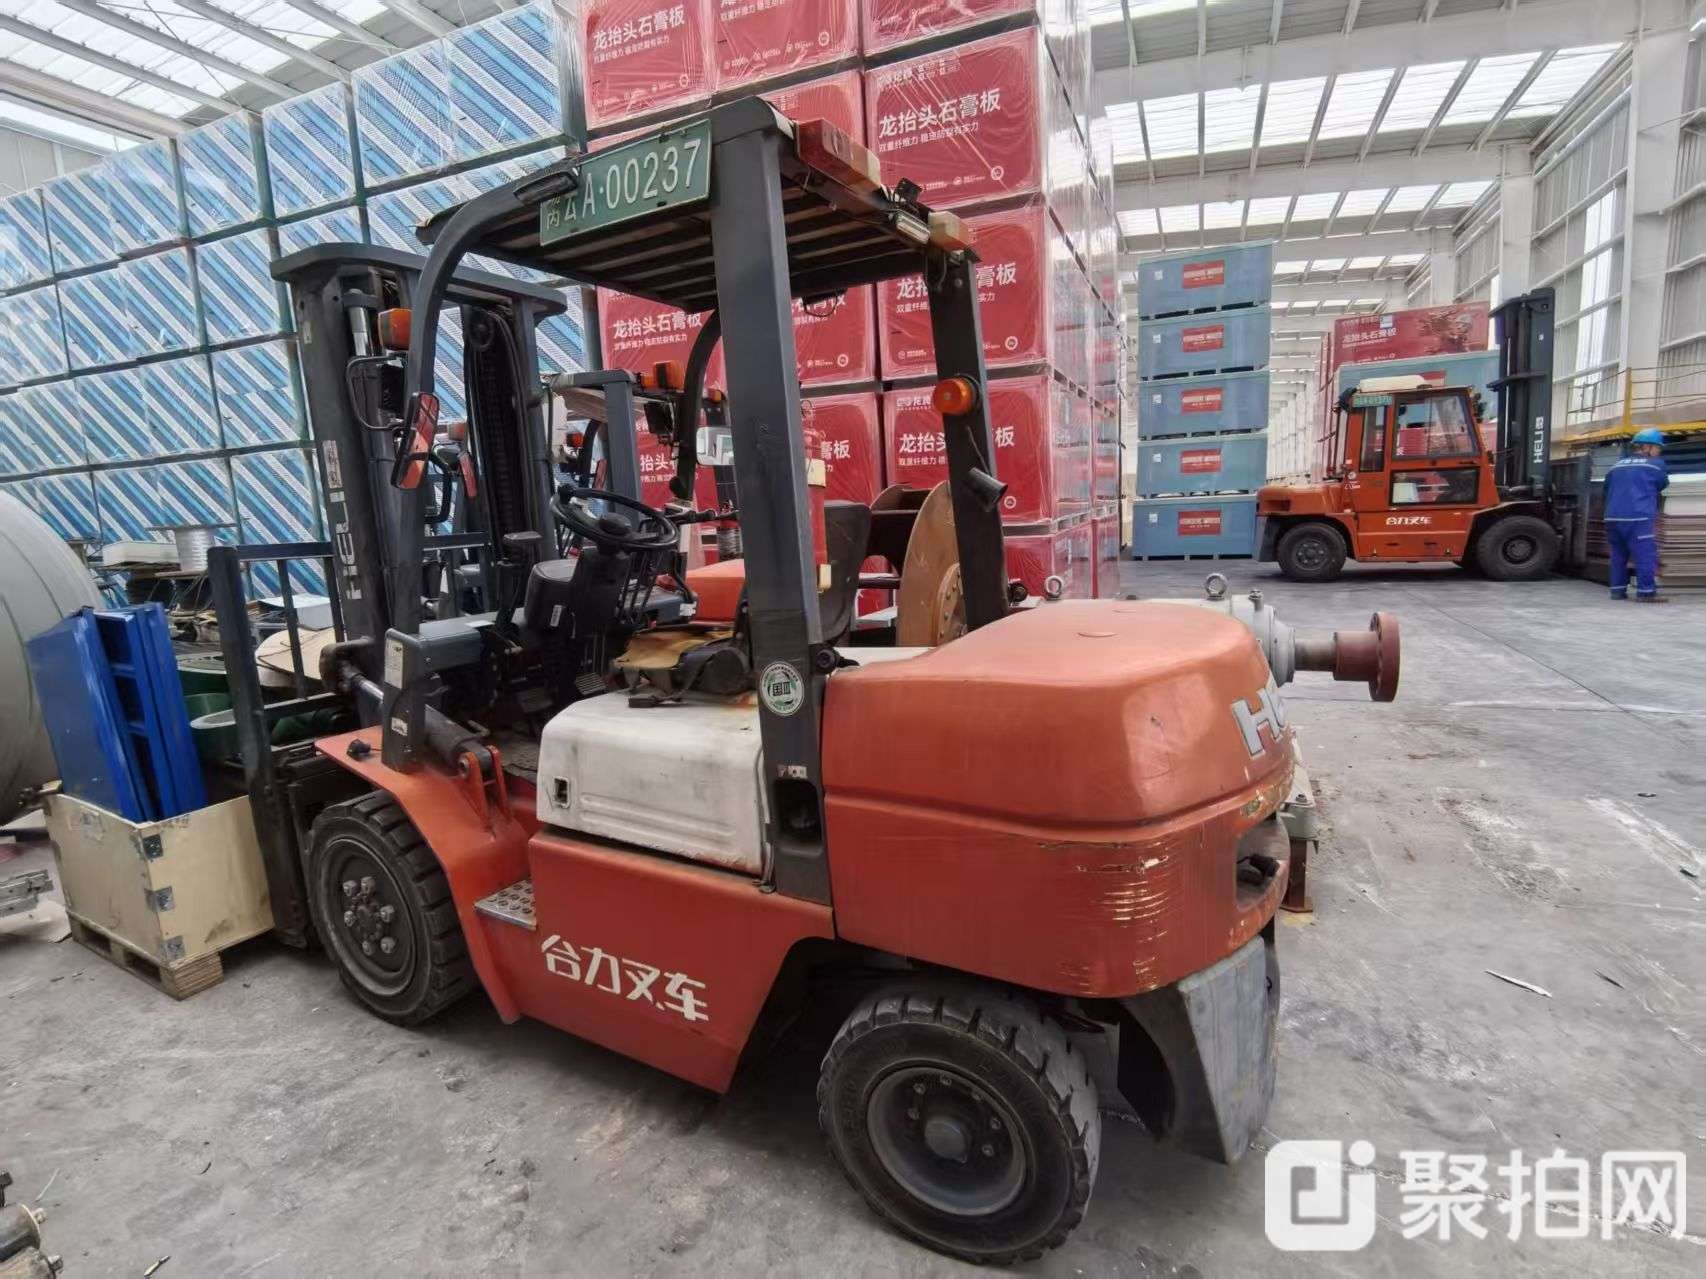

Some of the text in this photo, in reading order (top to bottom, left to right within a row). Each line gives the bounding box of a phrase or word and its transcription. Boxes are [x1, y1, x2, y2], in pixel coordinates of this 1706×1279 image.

[593, 4, 685, 51] 龙抬头石膏板
[879, 88, 1001, 138] 龙抬头石膏板
[976, 262, 1017, 288] 膏板
[613, 311, 703, 339] 龙抬头石膏板
[640, 453, 678, 472] 抬头
[1533, 430, 1544, 464] HELI
[541, 934, 709, 1022] 合力叉车
